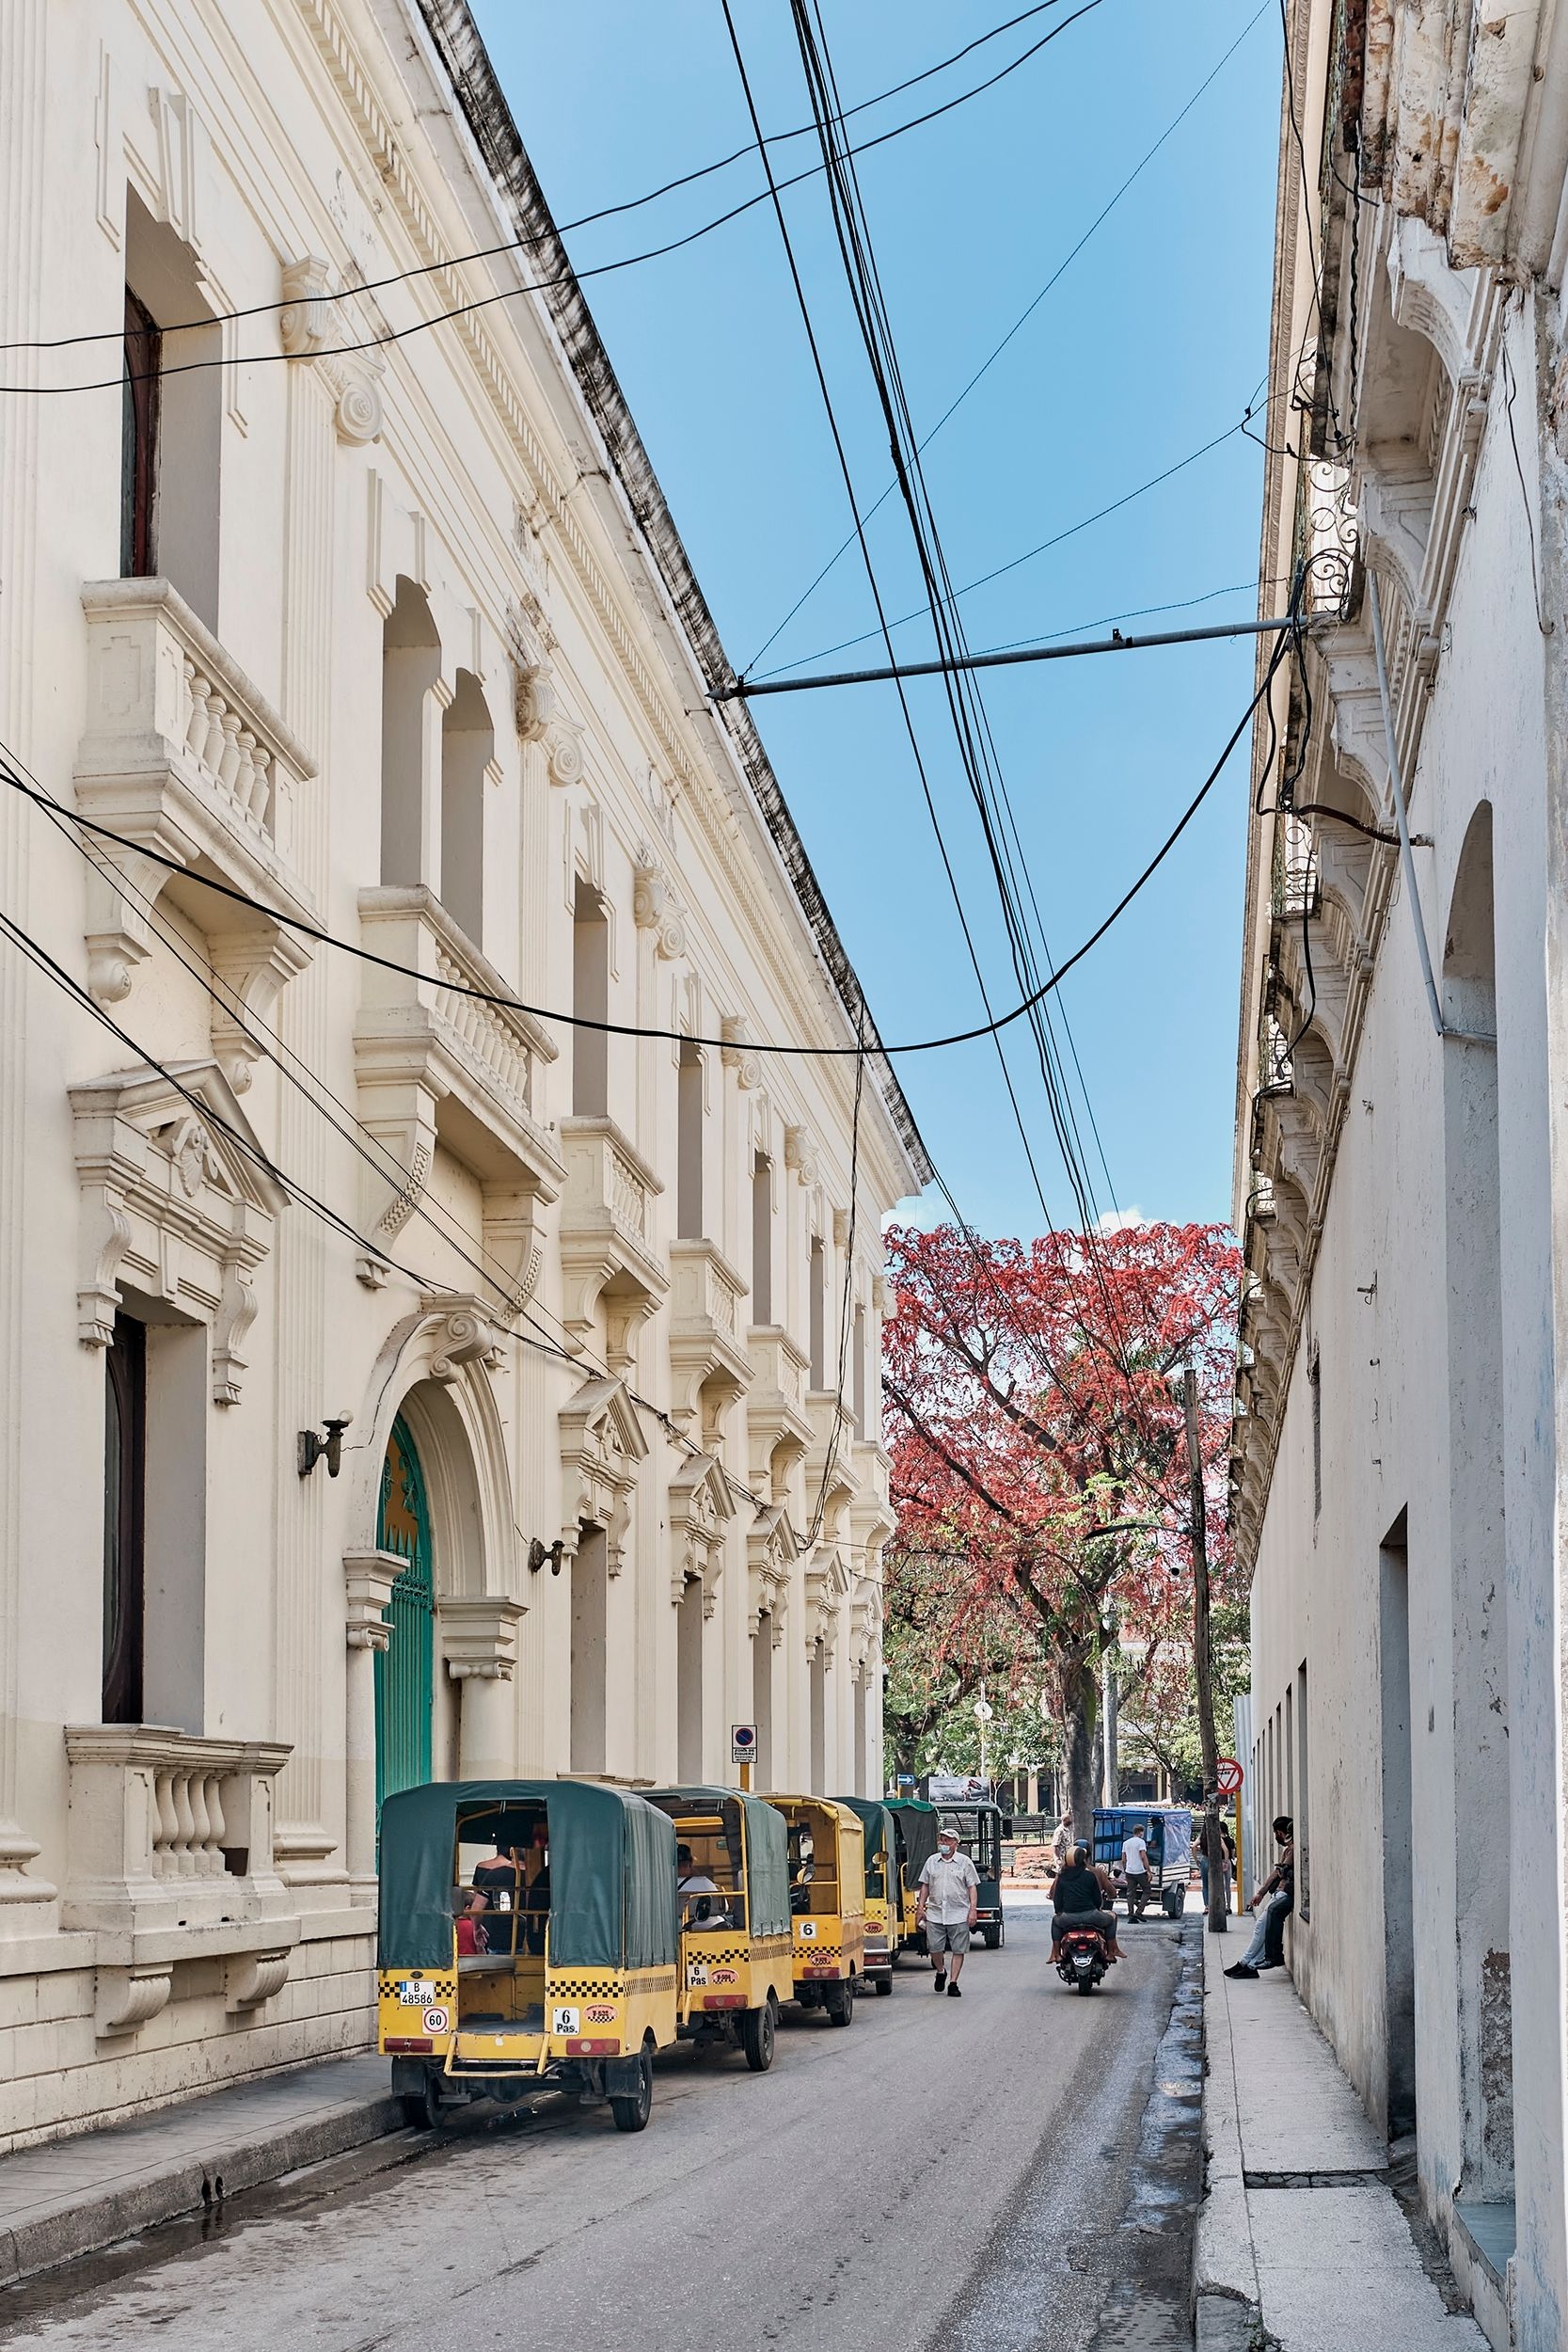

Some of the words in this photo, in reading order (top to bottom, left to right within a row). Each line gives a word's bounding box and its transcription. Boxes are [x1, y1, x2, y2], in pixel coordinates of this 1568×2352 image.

[802, 1924, 813, 1935] 6
[693, 1966, 700, 1976] 6
[690, 1977, 706, 1985] Pas
[414, 1982, 420, 1993] B
[402, 1994, 433, 2004] 48586
[429, 2014, 442, 2026] 60
[562, 2010, 570, 2024] 6
